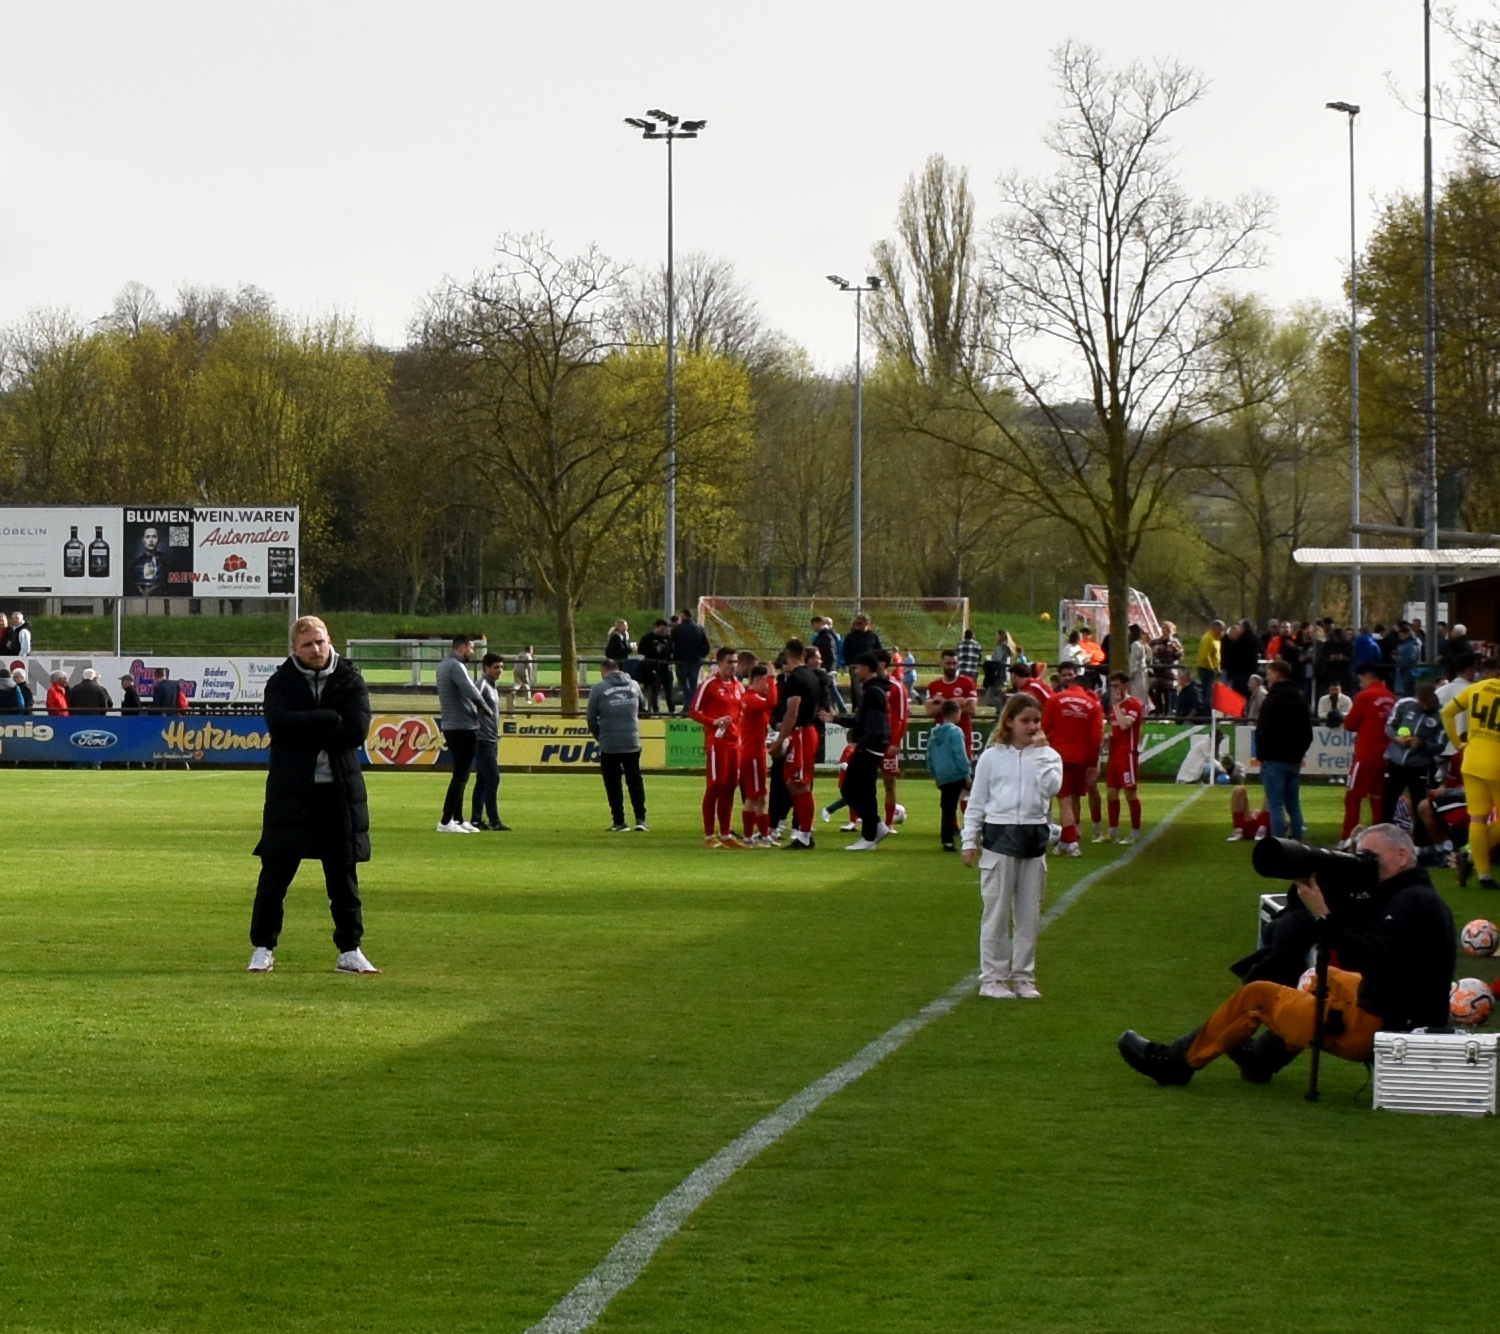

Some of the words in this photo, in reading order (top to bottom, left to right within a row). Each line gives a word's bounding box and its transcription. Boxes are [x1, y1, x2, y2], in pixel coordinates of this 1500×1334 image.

[199, 526, 291, 548] Automaten
[204, 667, 229, 677] Bäder
[256, 663, 276, 673] Vaill
[202, 679, 235, 690] Heizung
[200, 689, 231, 701] Lüftung
[240, 689, 264, 699] Bäde
[518, 722, 557, 735] aktiv
[77, 733, 109, 746] Ford
